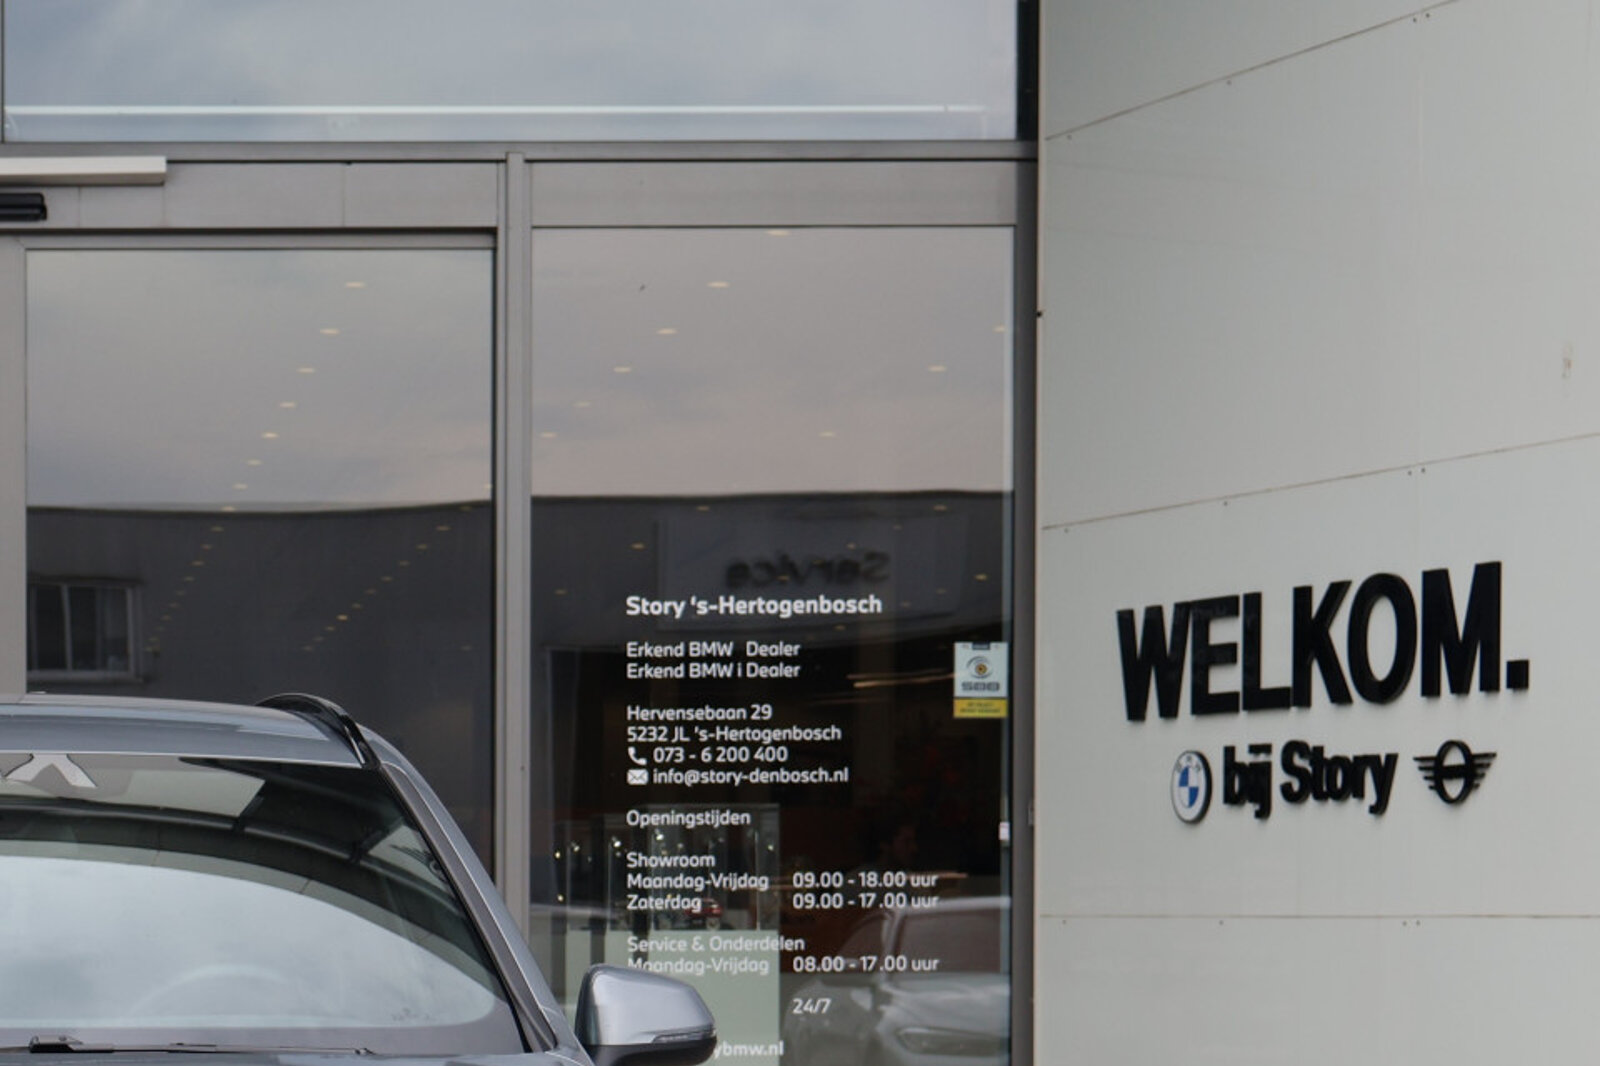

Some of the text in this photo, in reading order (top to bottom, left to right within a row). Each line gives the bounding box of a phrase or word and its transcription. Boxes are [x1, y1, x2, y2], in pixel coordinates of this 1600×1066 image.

[626, 596, 686, 618] Story
[627, 641, 800, 658] Erkend BMW Dealer
[1116, 561, 1530, 721] WELKOM.
[627, 662, 800, 679] Erkend BMW i Dealer
[627, 704, 773, 721] Hervensebaan 29
[627, 726, 668, 742] 5232
[672, 726, 690, 742] JL
[653, 747, 685, 763] 073
[701, 747, 712, 762] 6
[716, 747, 749, 762] 200
[754, 746, 788, 762] 400
[653, 767, 849, 786] info@story-denbosch.nl
[1223, 740, 1399, 820] bij Story
[626, 809, 751, 829] Openingstijden
[626, 852, 715, 868] Showroom
[627, 872, 769, 891] Maandag-Vrijdag
[792, 871, 843, 887] 09.00
[859, 871, 905, 887] 18.00
[911, 874, 939, 887] uur
[627, 894, 702, 912] Zaterdag
[792, 893, 843, 909] 09.00
[911, 896, 939, 909] uur
[627, 935, 805, 953] Service & Onderdelen
[792, 956, 843, 972] 08.00
[911, 958, 940, 971] uur
[792, 998, 831, 1015] 24/7
[713, 1041, 784, 1059] ybmw.nl
